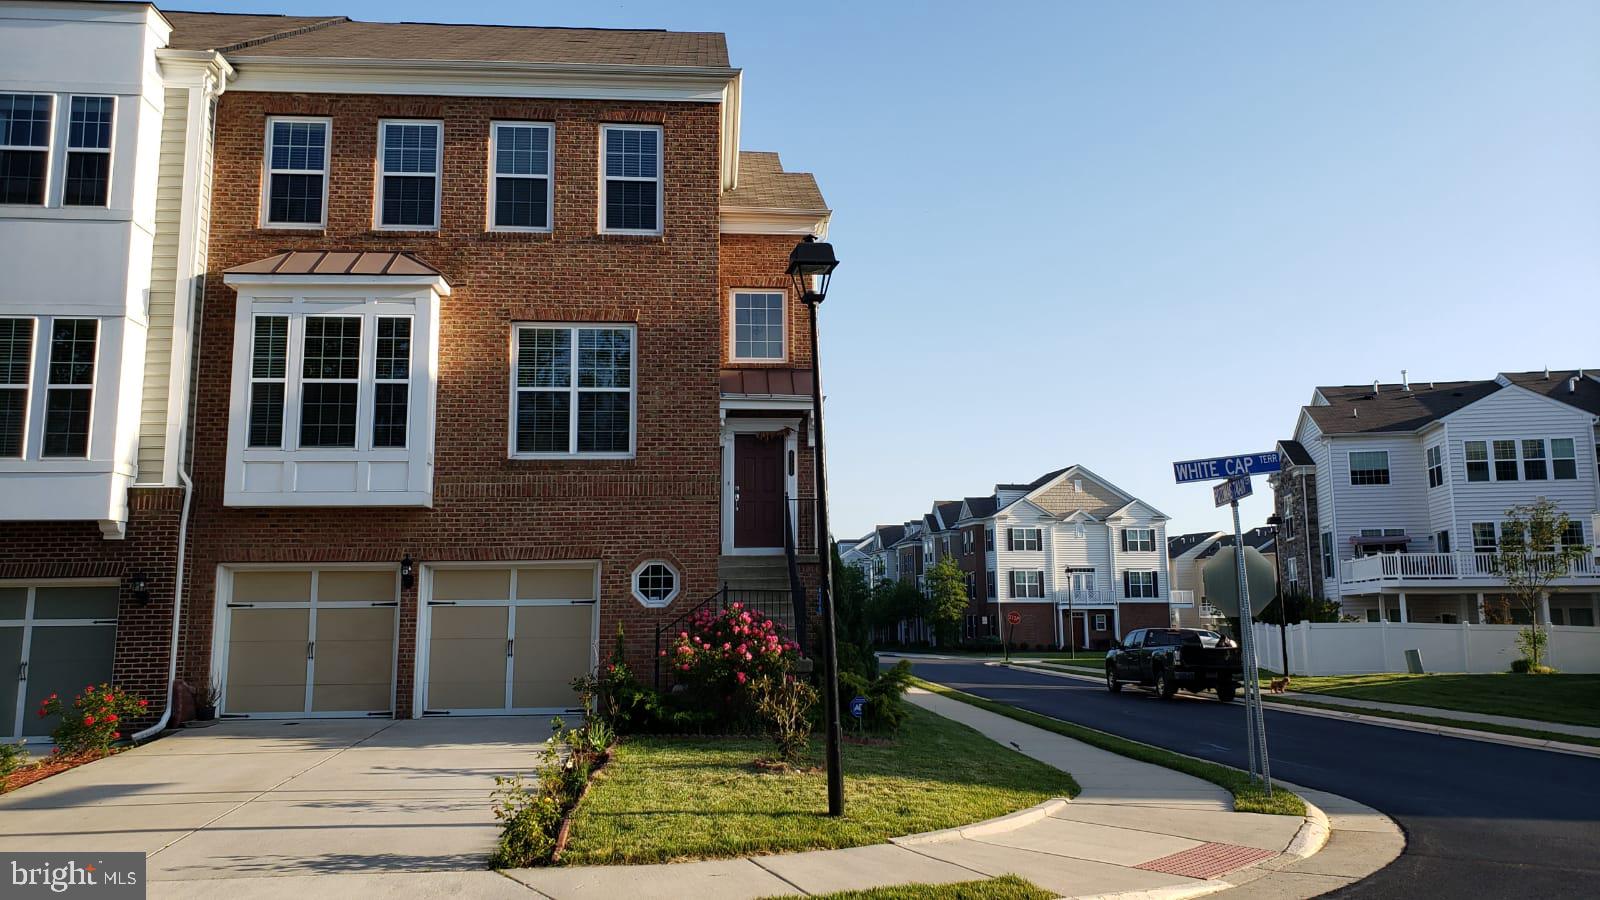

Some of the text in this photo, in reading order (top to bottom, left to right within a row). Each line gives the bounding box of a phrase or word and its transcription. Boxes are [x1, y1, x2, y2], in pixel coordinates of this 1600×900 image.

[1176, 454, 1278, 481] WHITE CAP TERR
